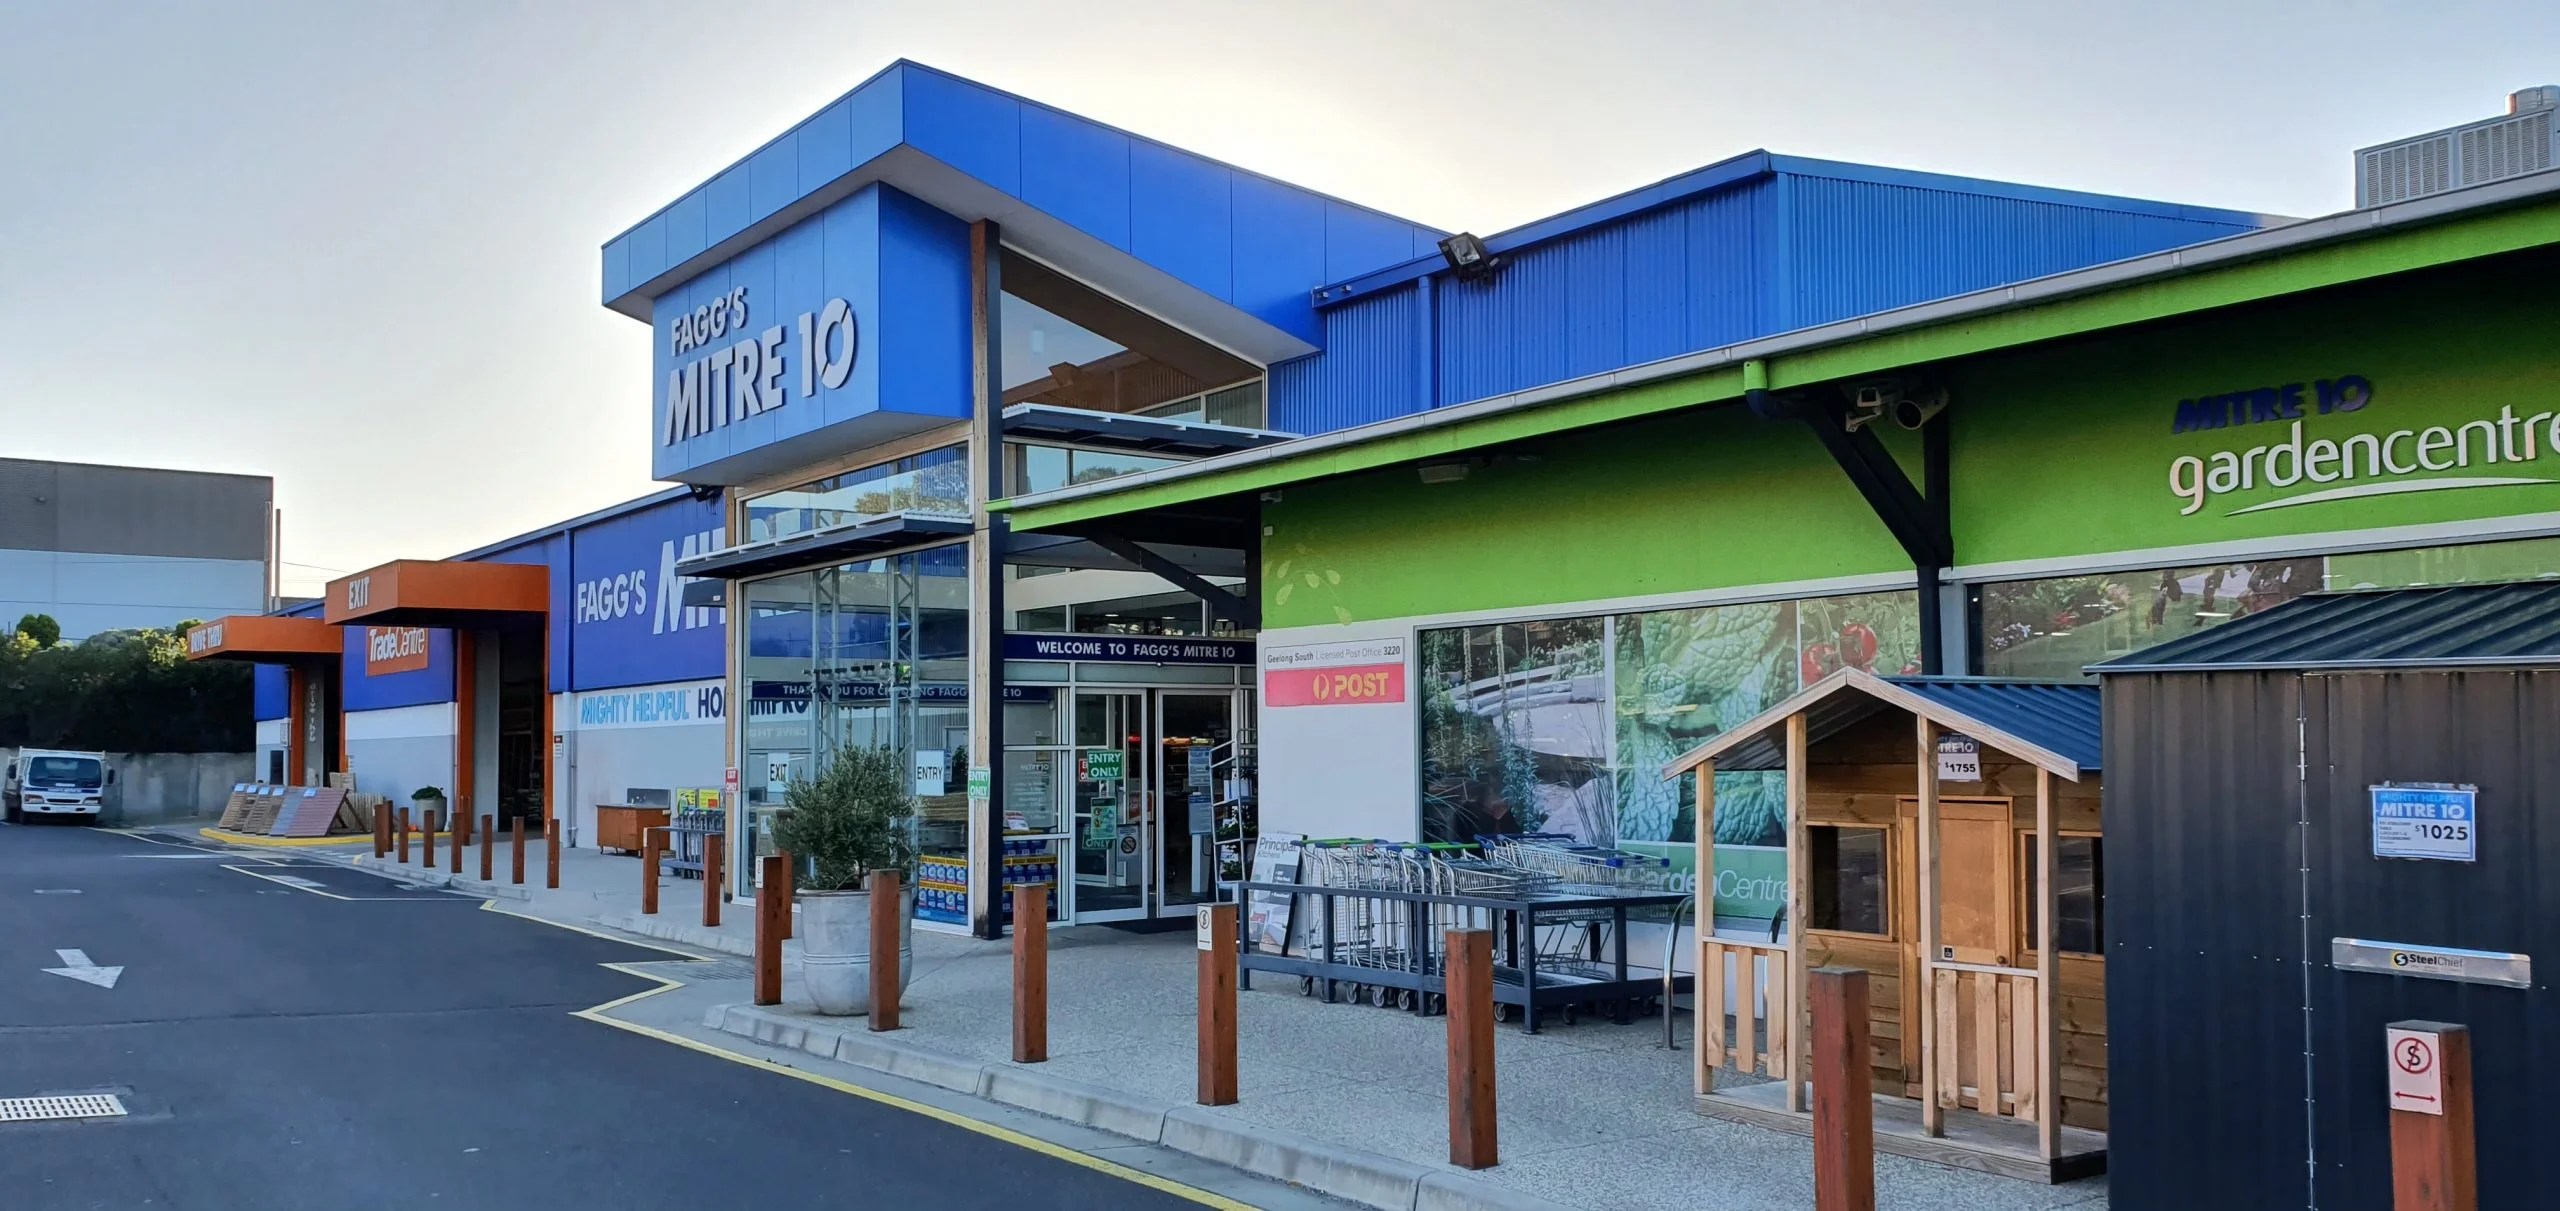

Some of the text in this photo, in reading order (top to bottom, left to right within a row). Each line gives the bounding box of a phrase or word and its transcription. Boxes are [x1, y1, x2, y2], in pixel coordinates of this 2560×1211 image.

[671, 286, 746, 356] FAGG'S
[663, 298, 856, 446] MITRE 10
[2172, 374, 2372, 434] MITRE 10
[348, 576, 370, 610] EXIT
[577, 569, 647, 624] FAGG'S
[207, 624, 222, 649] THRU
[1037, 641, 1235, 658] WELCOME TO FAGG'S MITRE 10
[1267, 646, 1400, 664] Geelong South Licensed Post Office 3220
[783, 685, 816, 695] THA
[854, 686, 874, 695] FOR
[939, 687, 967, 697] FAGG
[1010, 688, 1022, 697] 10
[1334, 672, 1389, 698] POST
[580, 694, 630, 724] MIGHTY
[633, 689, 689, 722] HELPFUL
[698, 686, 726, 719] HO
[1937, 742, 1974, 752] TRE 10
[1088, 752, 1122, 764] ENTRY
[1945, 761, 1976, 772] $1755
[769, 763, 787, 782] EXIT
[917, 766, 943, 780] ENTRY
[969, 770, 988, 781] ENTRY
[1090, 767, 1119, 777] ONLY
[970, 785, 988, 796] ONLY
[2380, 802, 2465, 819] MITRE 10
[2415, 824, 2468, 840] $1025
[1085, 839, 1110, 848] ONLY
[2409, 954, 2463, 967] SteelChief
